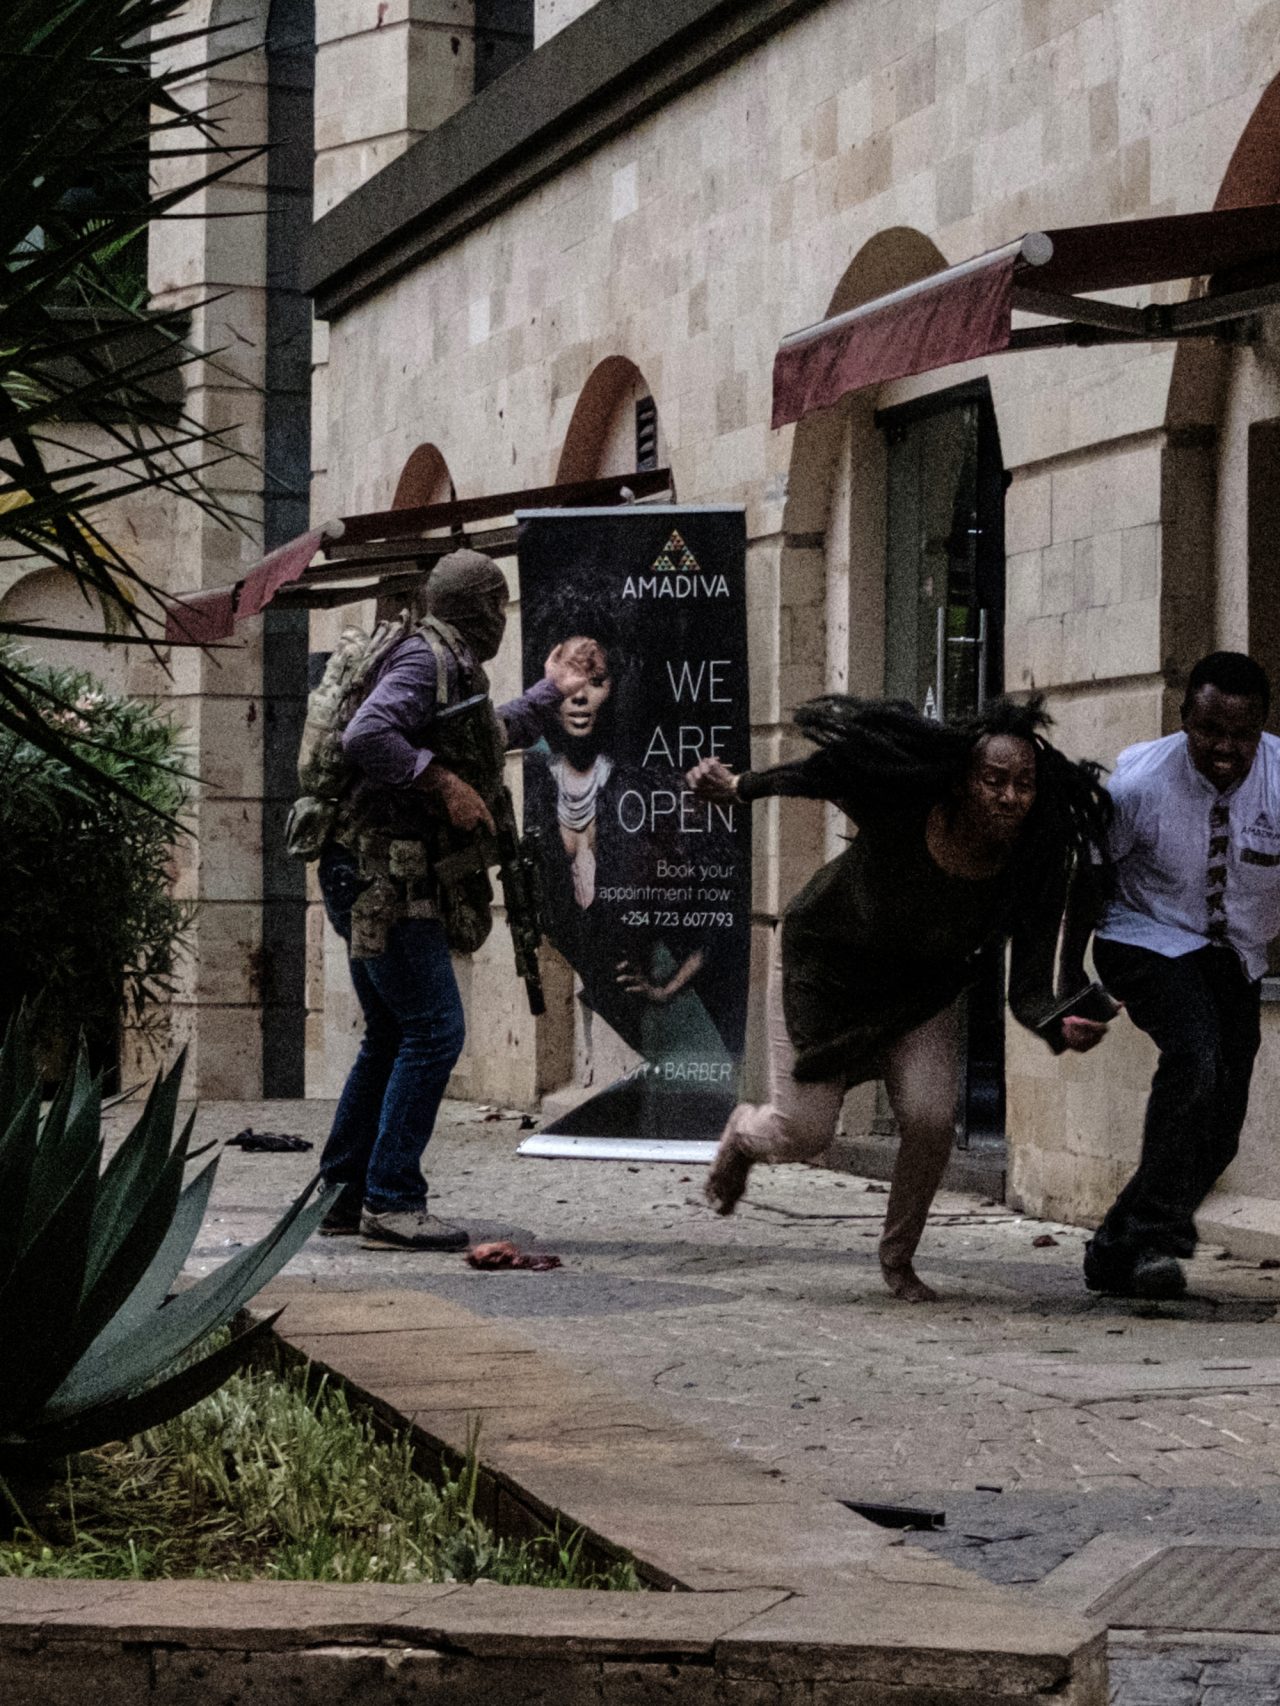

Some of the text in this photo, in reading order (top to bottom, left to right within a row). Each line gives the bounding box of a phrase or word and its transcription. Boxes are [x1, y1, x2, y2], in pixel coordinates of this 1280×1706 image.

[621, 574, 730, 599] AMADIVA
[666, 660, 733, 703] WE
[641, 725, 733, 768] ARE
[656, 859, 735, 882] Book your
[599, 884, 693, 902] appointment
[619, 910, 735, 928] +254 723 607793
[664, 1061, 733, 1082] BARBER
